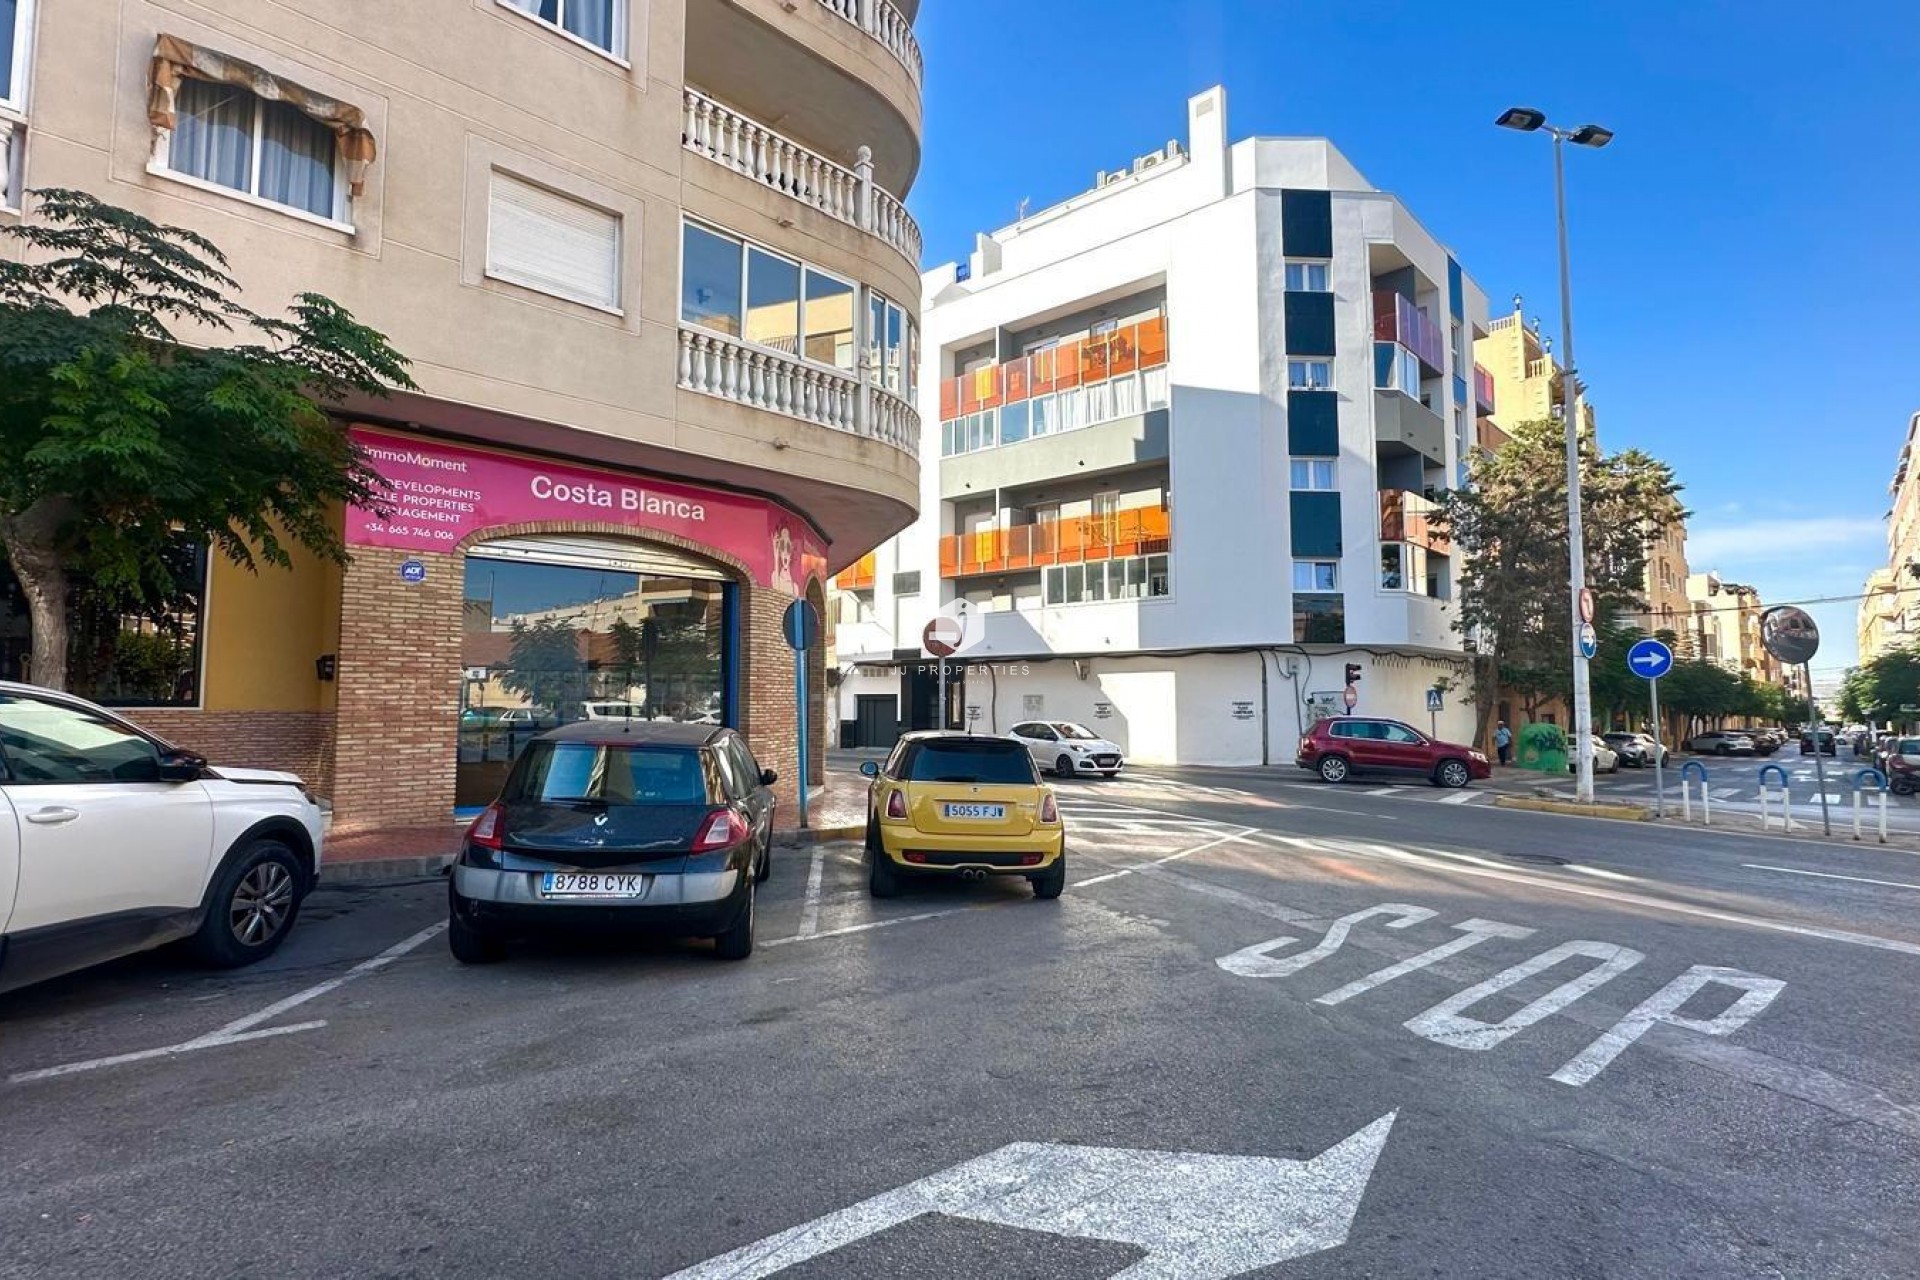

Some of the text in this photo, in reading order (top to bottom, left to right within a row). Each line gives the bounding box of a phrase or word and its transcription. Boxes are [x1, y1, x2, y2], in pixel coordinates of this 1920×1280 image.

[402, 494, 475, 513] PROPERTIES
[530, 475, 705, 521] Costa Blanca
[364, 522, 454, 540] +34 665 746 006
[555, 875, 637, 891] 8788 CYK
[1214, 902, 1788, 1087] STOP
